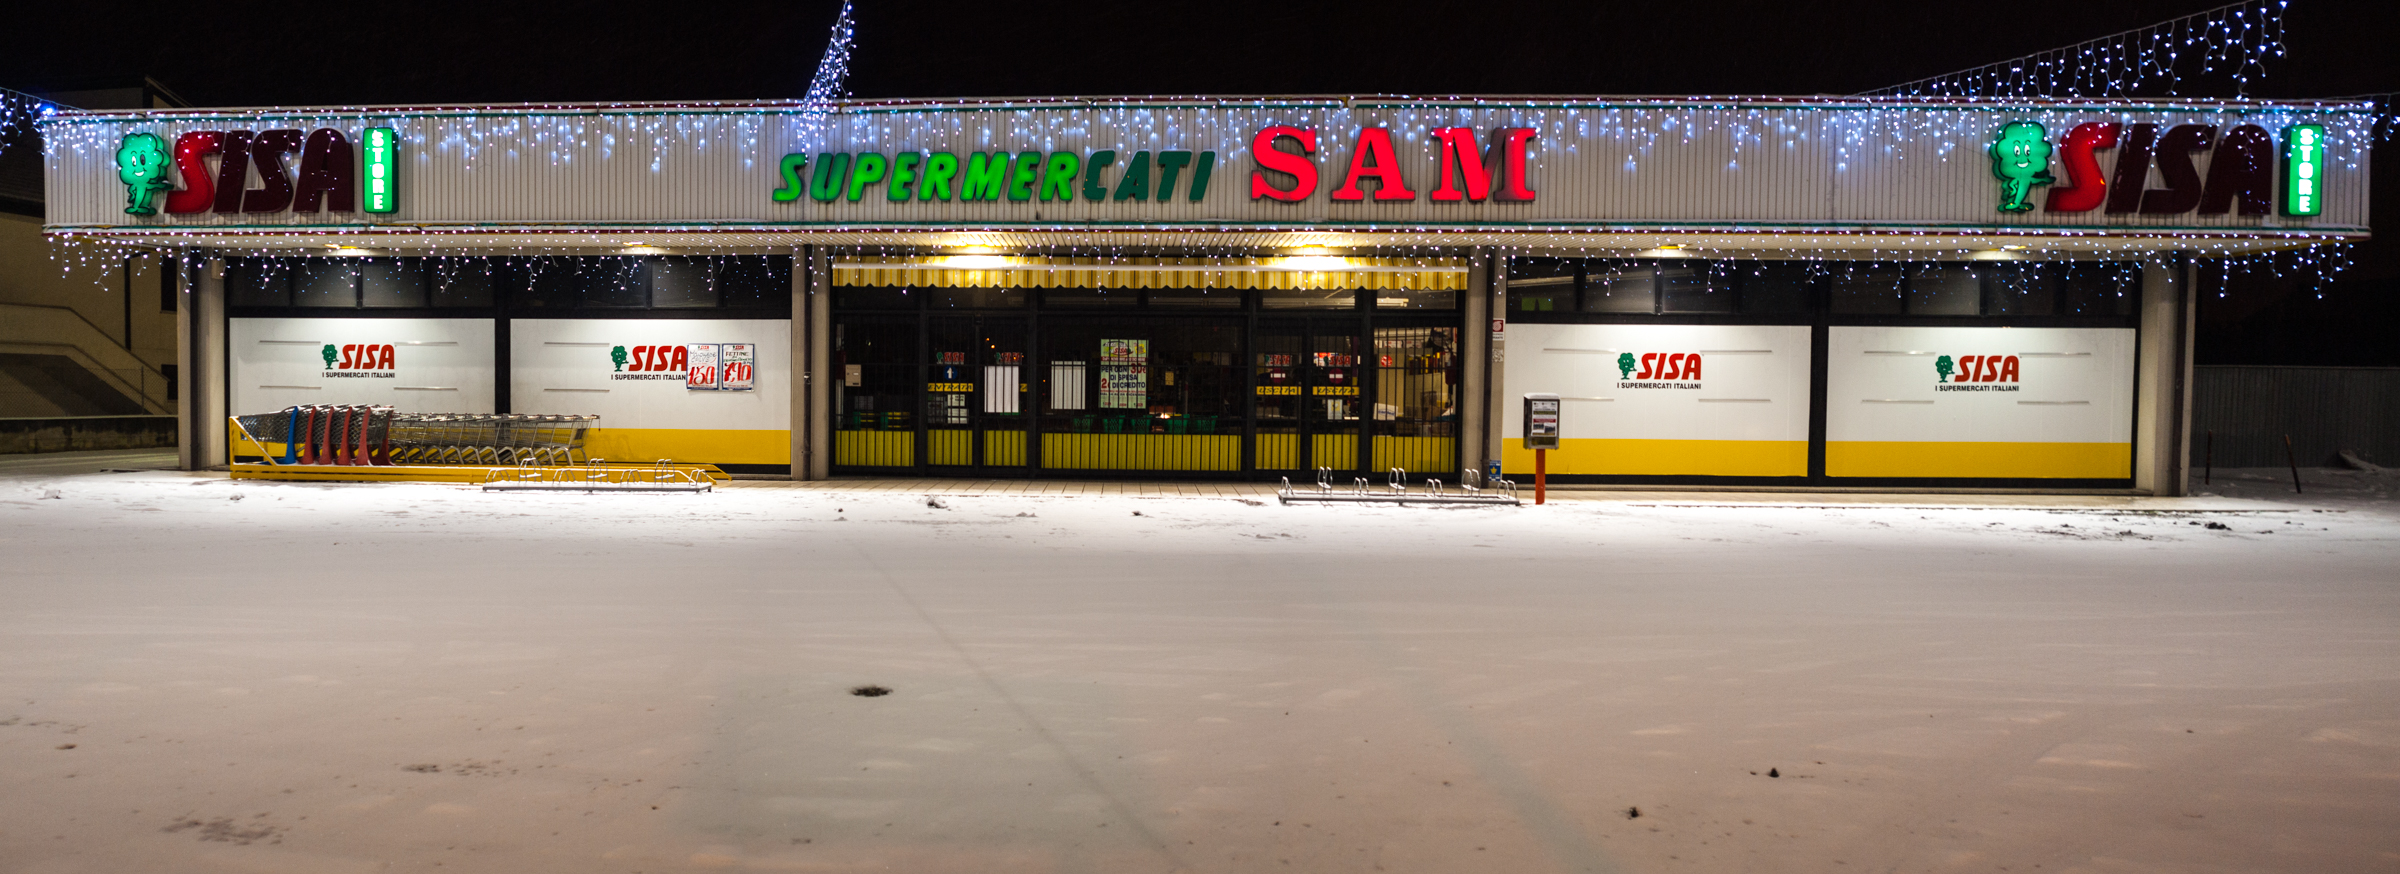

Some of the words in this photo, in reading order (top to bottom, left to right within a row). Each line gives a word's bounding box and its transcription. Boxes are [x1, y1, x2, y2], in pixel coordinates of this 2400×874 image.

[164, 128, 355, 213] SISA
[371, 130, 384, 210] STORE
[772, 149, 1216, 202] SUPERMERCATI
[1251, 125, 1536, 202] SAM
[2044, 122, 2274, 215] SISA
[2299, 128, 2315, 212] STORE
[338, 344, 395, 370] SISA
[628, 345, 687, 372] SISA
[1636, 353, 1702, 380] SISA
[1954, 355, 2019, 382] SISA
